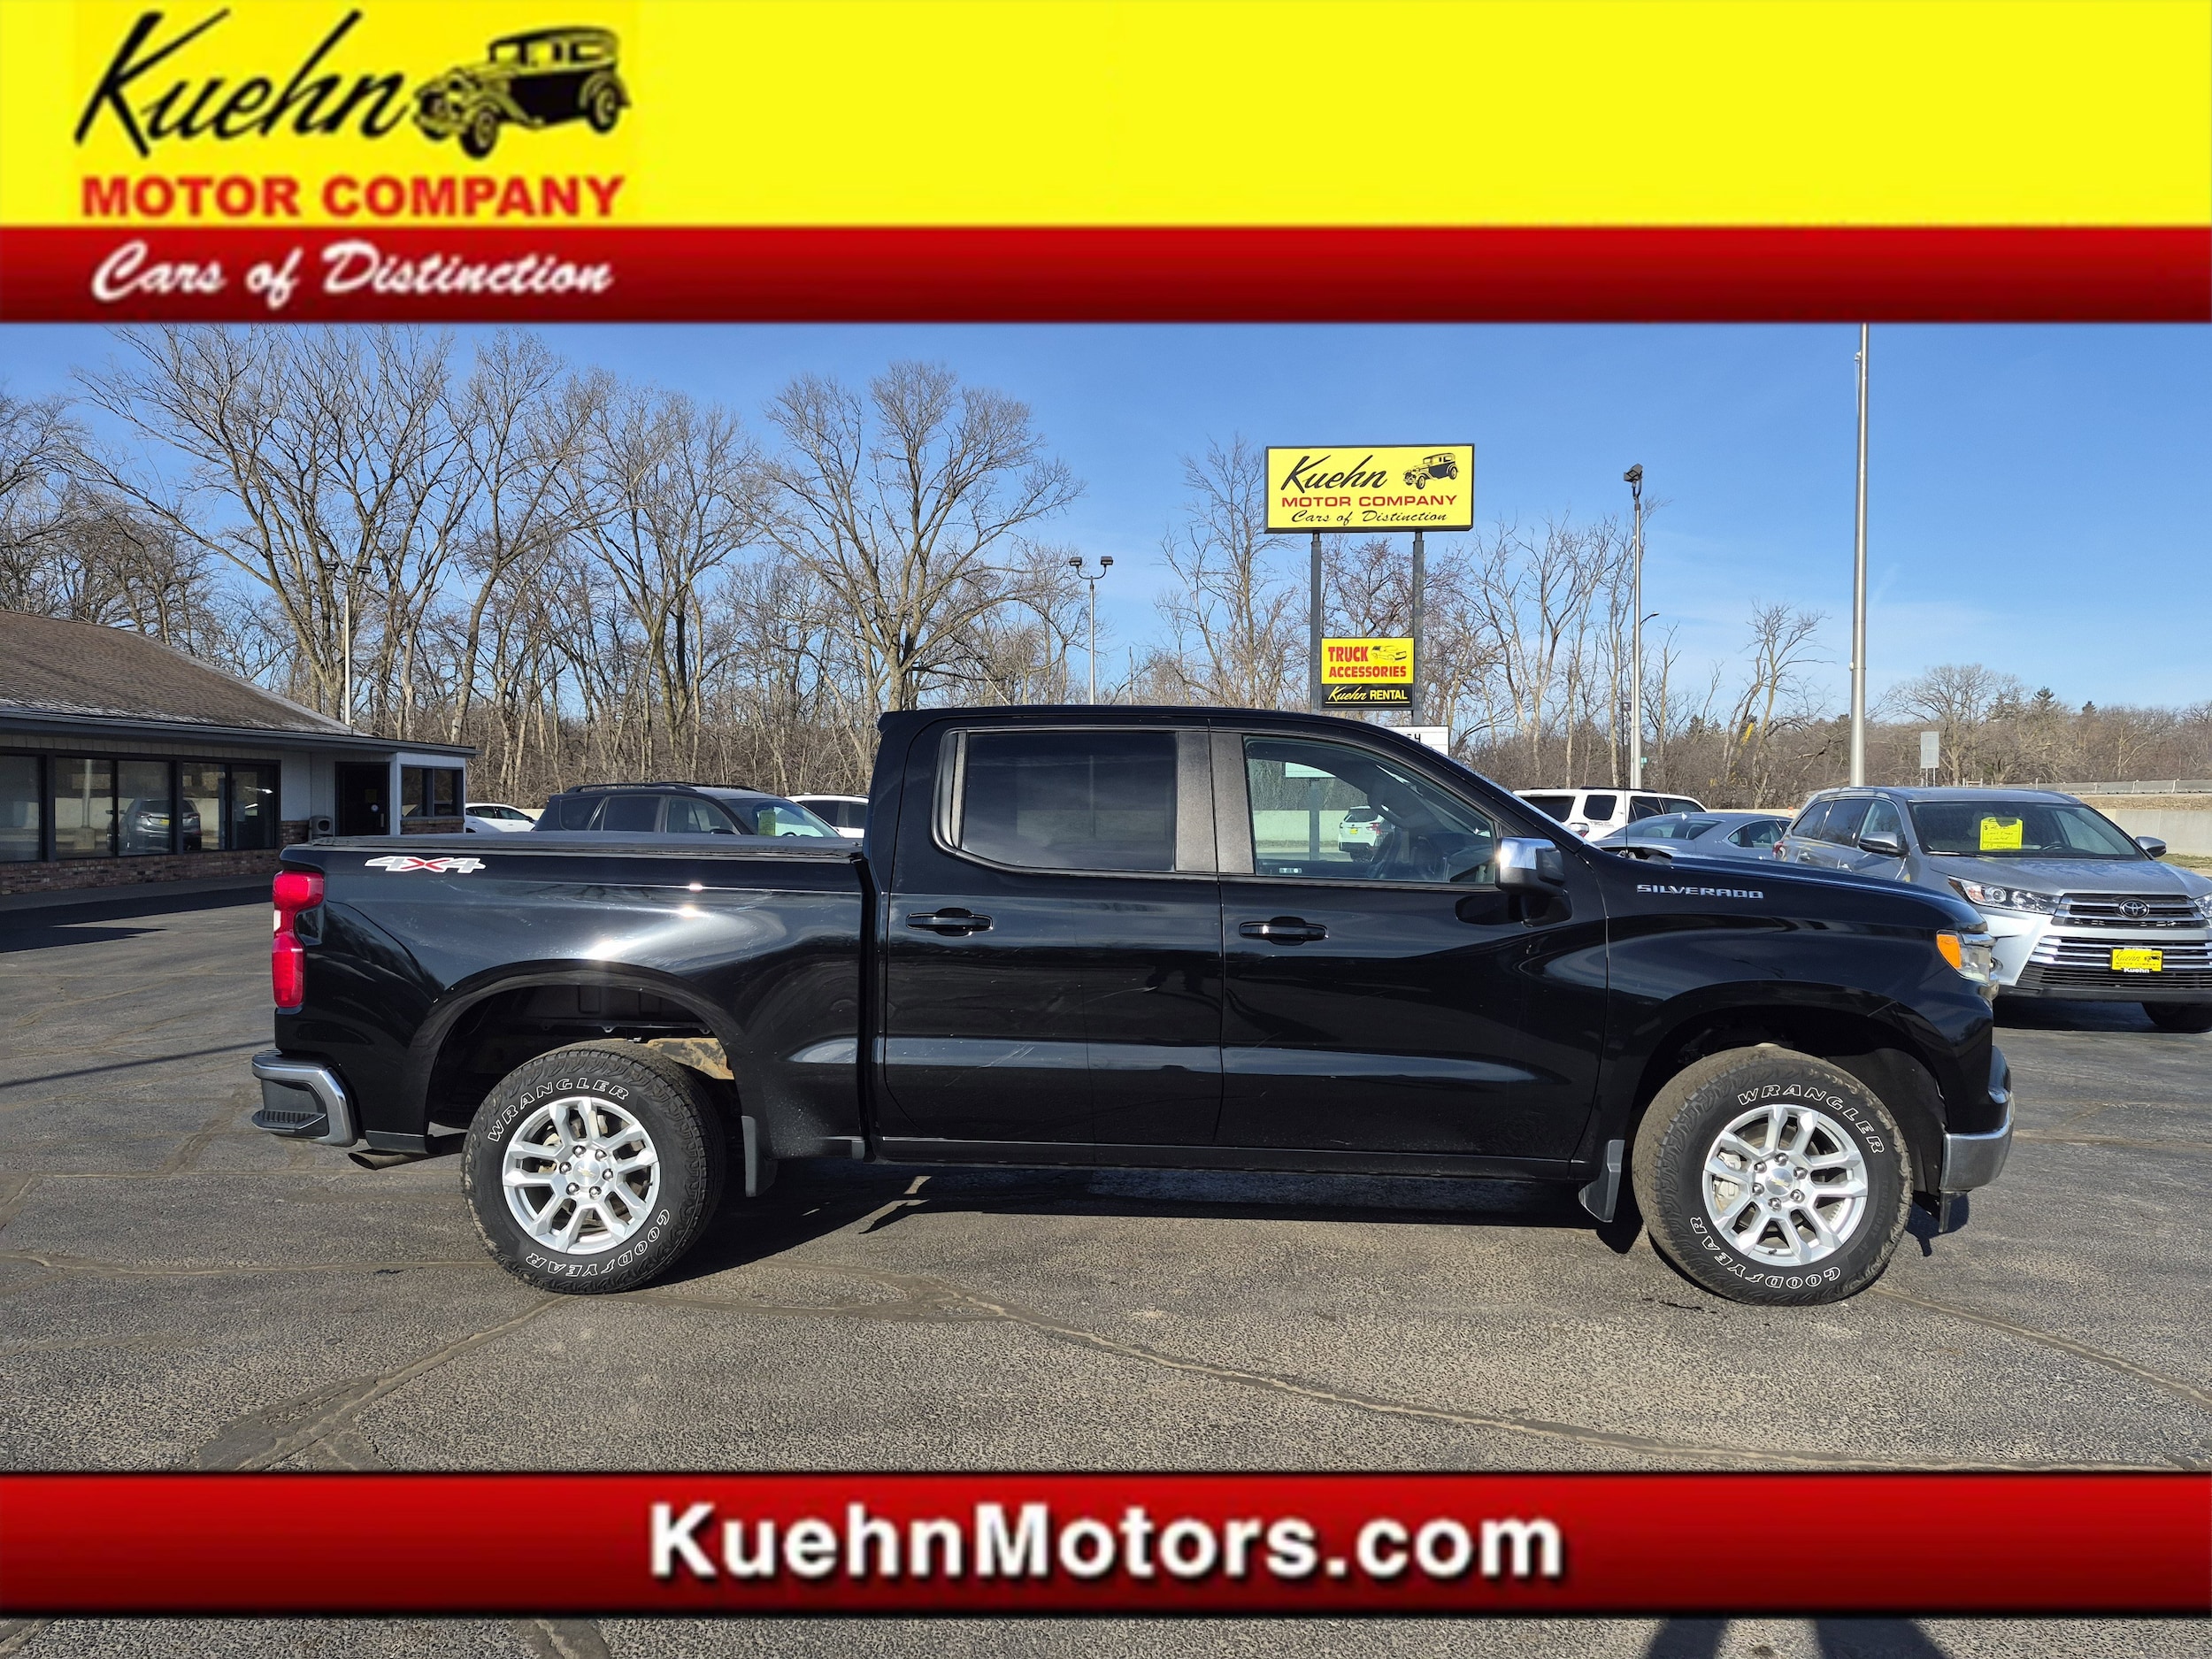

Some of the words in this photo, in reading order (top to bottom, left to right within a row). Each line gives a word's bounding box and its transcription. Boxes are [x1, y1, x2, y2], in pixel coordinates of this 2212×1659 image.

[1280, 454, 1388, 494] Kuehn
[1281, 496, 1351, 508] MOTOR
[1358, 495, 1457, 508] COMPANY
[1291, 510, 1332, 522] Cars
[1336, 511, 1354, 526] of
[1362, 510, 1448, 523] Distinction
[1328, 646, 1369, 663] TRUCK
[1329, 665, 1407, 678] ACCESSORIES
[1328, 686, 1368, 702] Kuehn
[1370, 689, 1408, 700] RENTAL
[1637, 884, 1764, 899] SILVERADO
[488, 1077, 629, 1143] WRANGLER
[1737, 1084, 1885, 1154] WRANGLER
[526, 1209, 672, 1278] GOODYEAR
[1690, 1216, 1841, 1289] GOODYEAR
